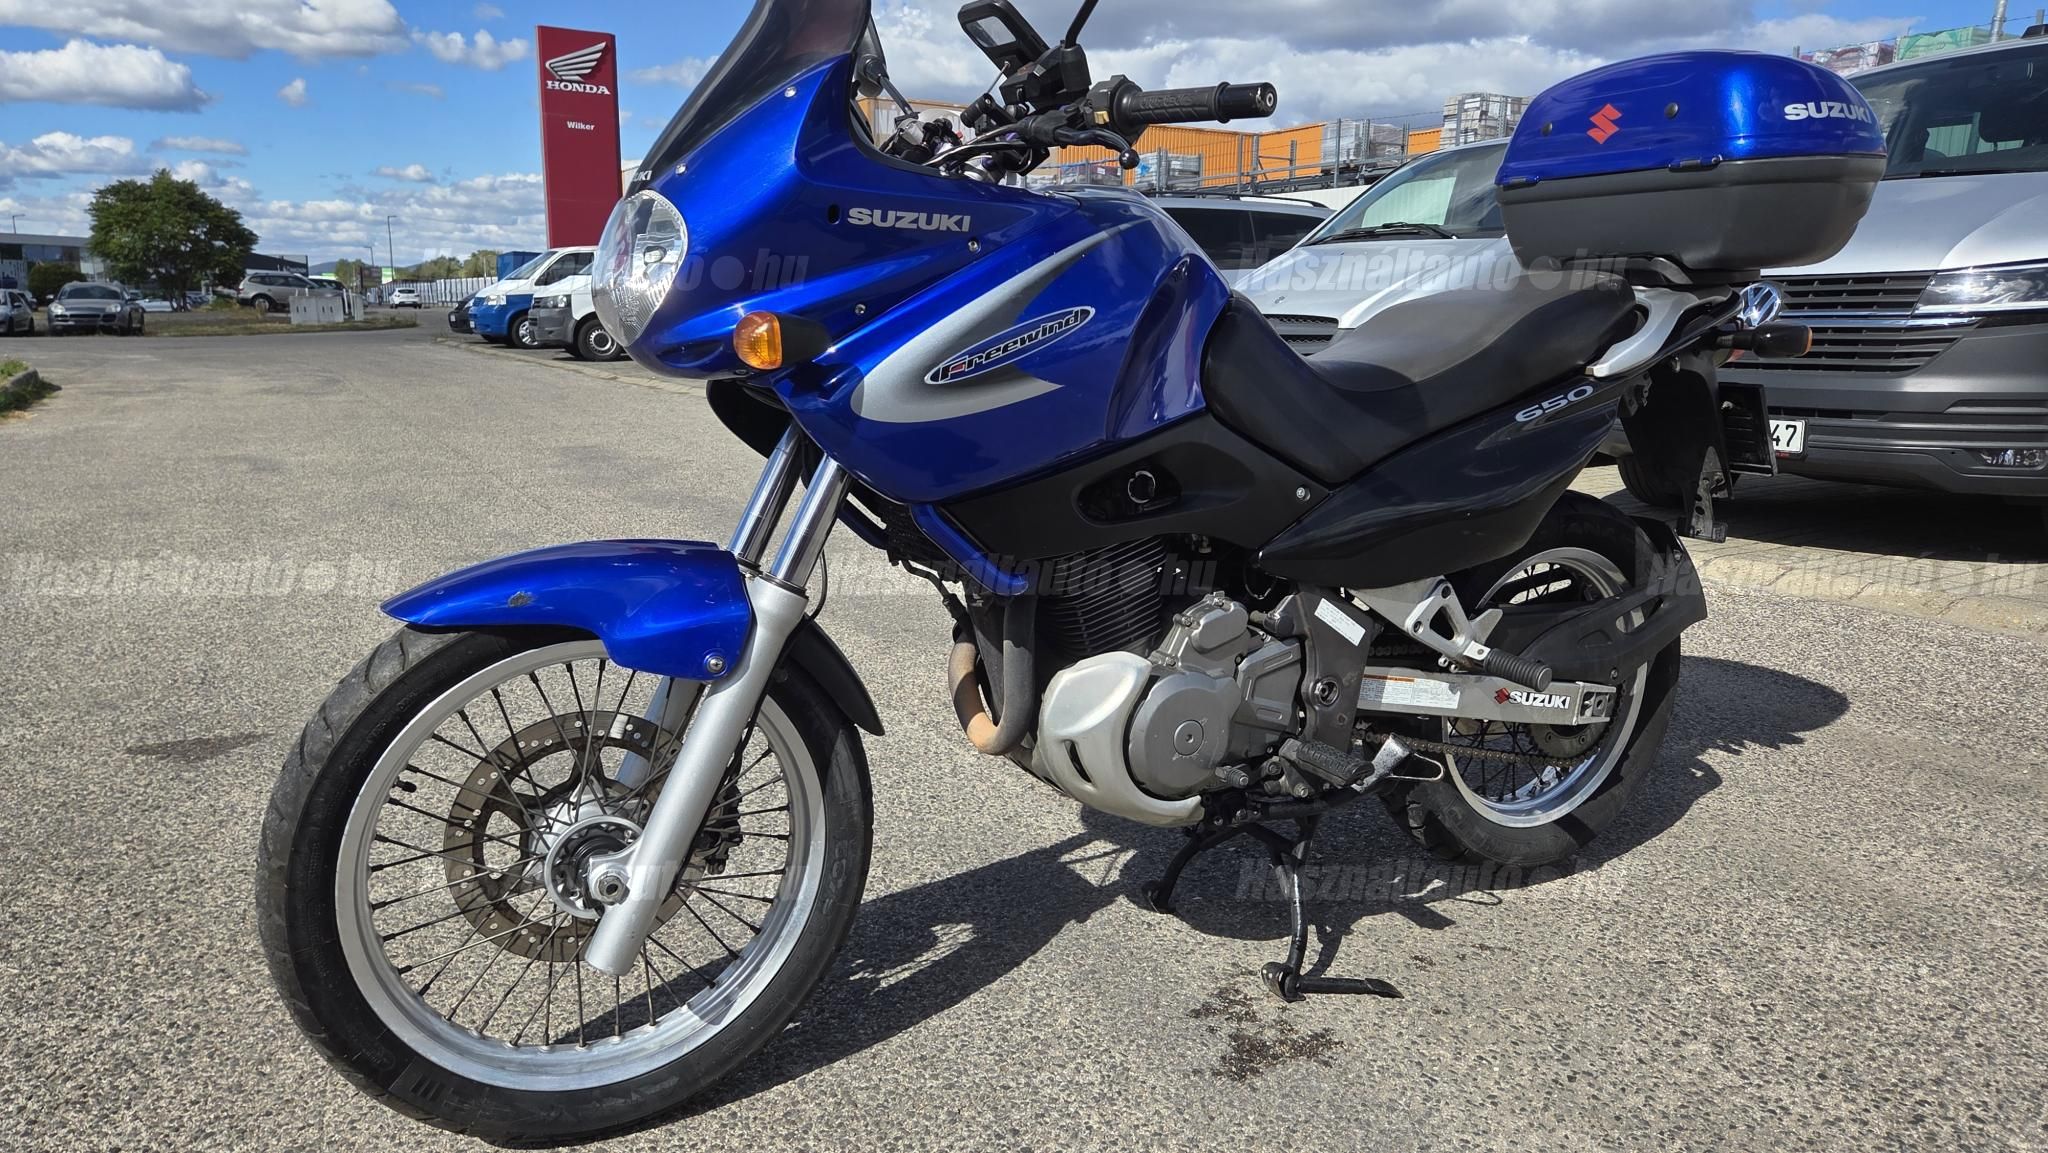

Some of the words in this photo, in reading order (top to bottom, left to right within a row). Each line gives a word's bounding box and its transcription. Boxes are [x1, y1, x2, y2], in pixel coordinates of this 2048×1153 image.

[546, 80, 611, 95] HONDA
[1784, 101, 1872, 124] SUZUKI
[566, 121, 595, 131] Wilker
[847, 207, 971, 232] SUZUKI
[939, 309, 1081, 383] Freewind
[1515, 385, 1594, 422] 650
[1771, 423, 1797, 448] 47
[1509, 691, 1570, 709] SUZUKI
